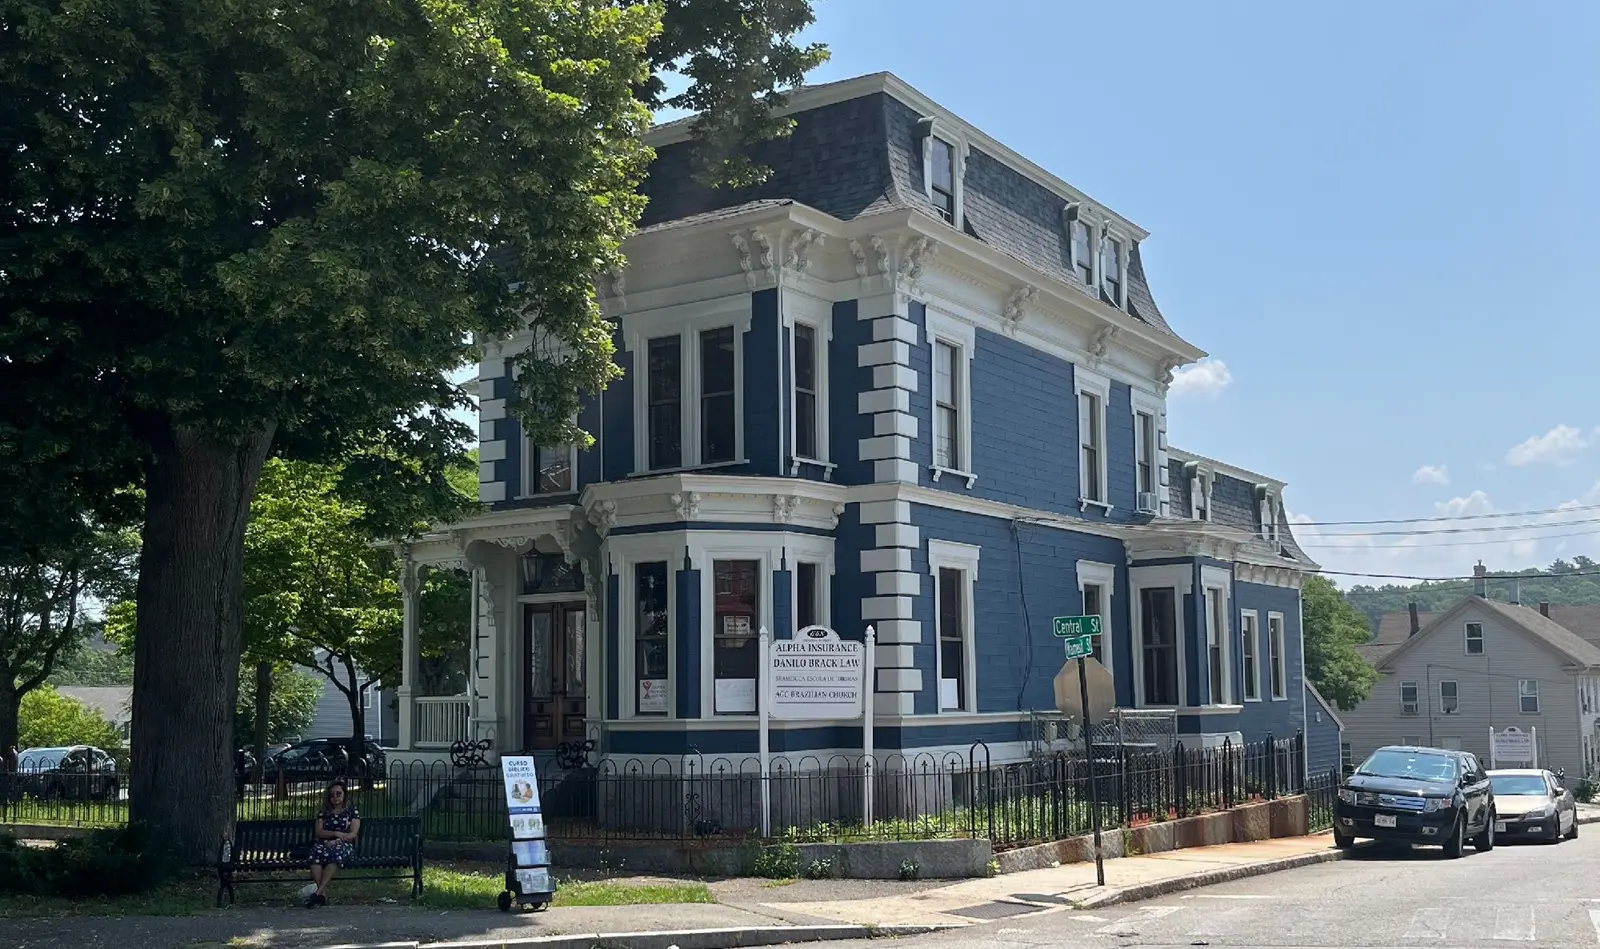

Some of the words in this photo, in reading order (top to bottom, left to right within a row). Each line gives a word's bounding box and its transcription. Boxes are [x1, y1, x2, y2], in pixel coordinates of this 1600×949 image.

[1055, 619, 1083, 634] Central
[1090, 618, 1099, 632] St
[776, 643, 806, 652] ALPHA
[808, 643, 859, 652] INSURANCE
[773, 659, 807, 668] DANILO
[808, 659, 838, 668] BRACK
[840, 659, 860, 668] LAW
[790, 690, 828, 698] BRAZILIAN
